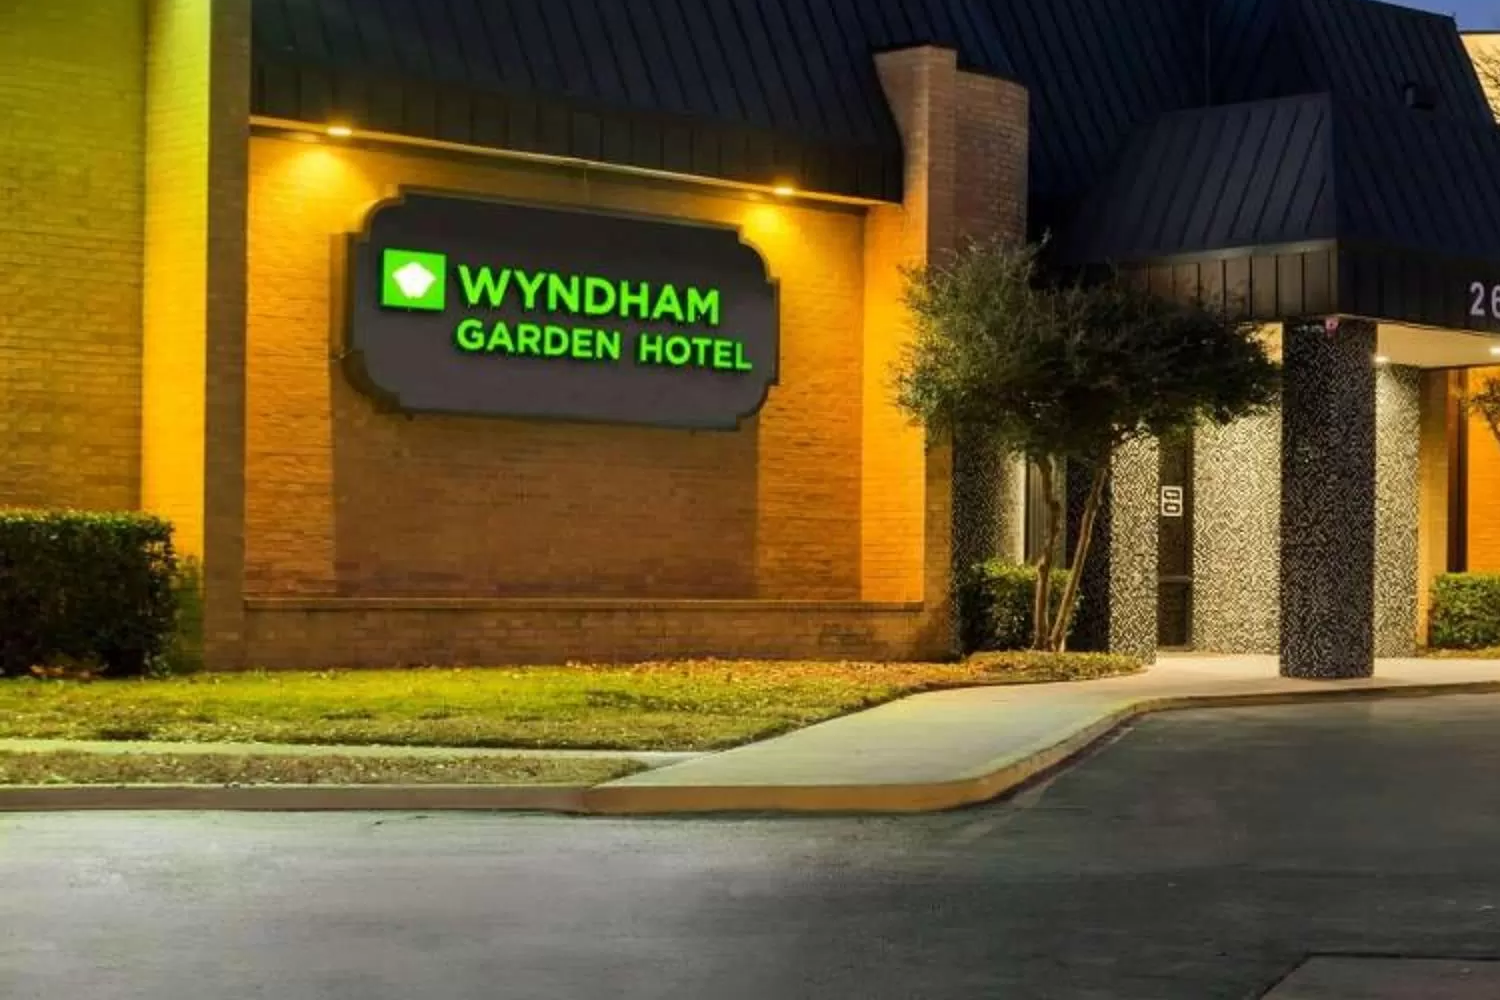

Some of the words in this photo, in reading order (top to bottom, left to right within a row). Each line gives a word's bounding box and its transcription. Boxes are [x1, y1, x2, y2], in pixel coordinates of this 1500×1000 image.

[459, 265, 720, 325] WYNDHAM
[457, 319, 621, 360] GARDEN
[639, 334, 753, 370] HOTEL
